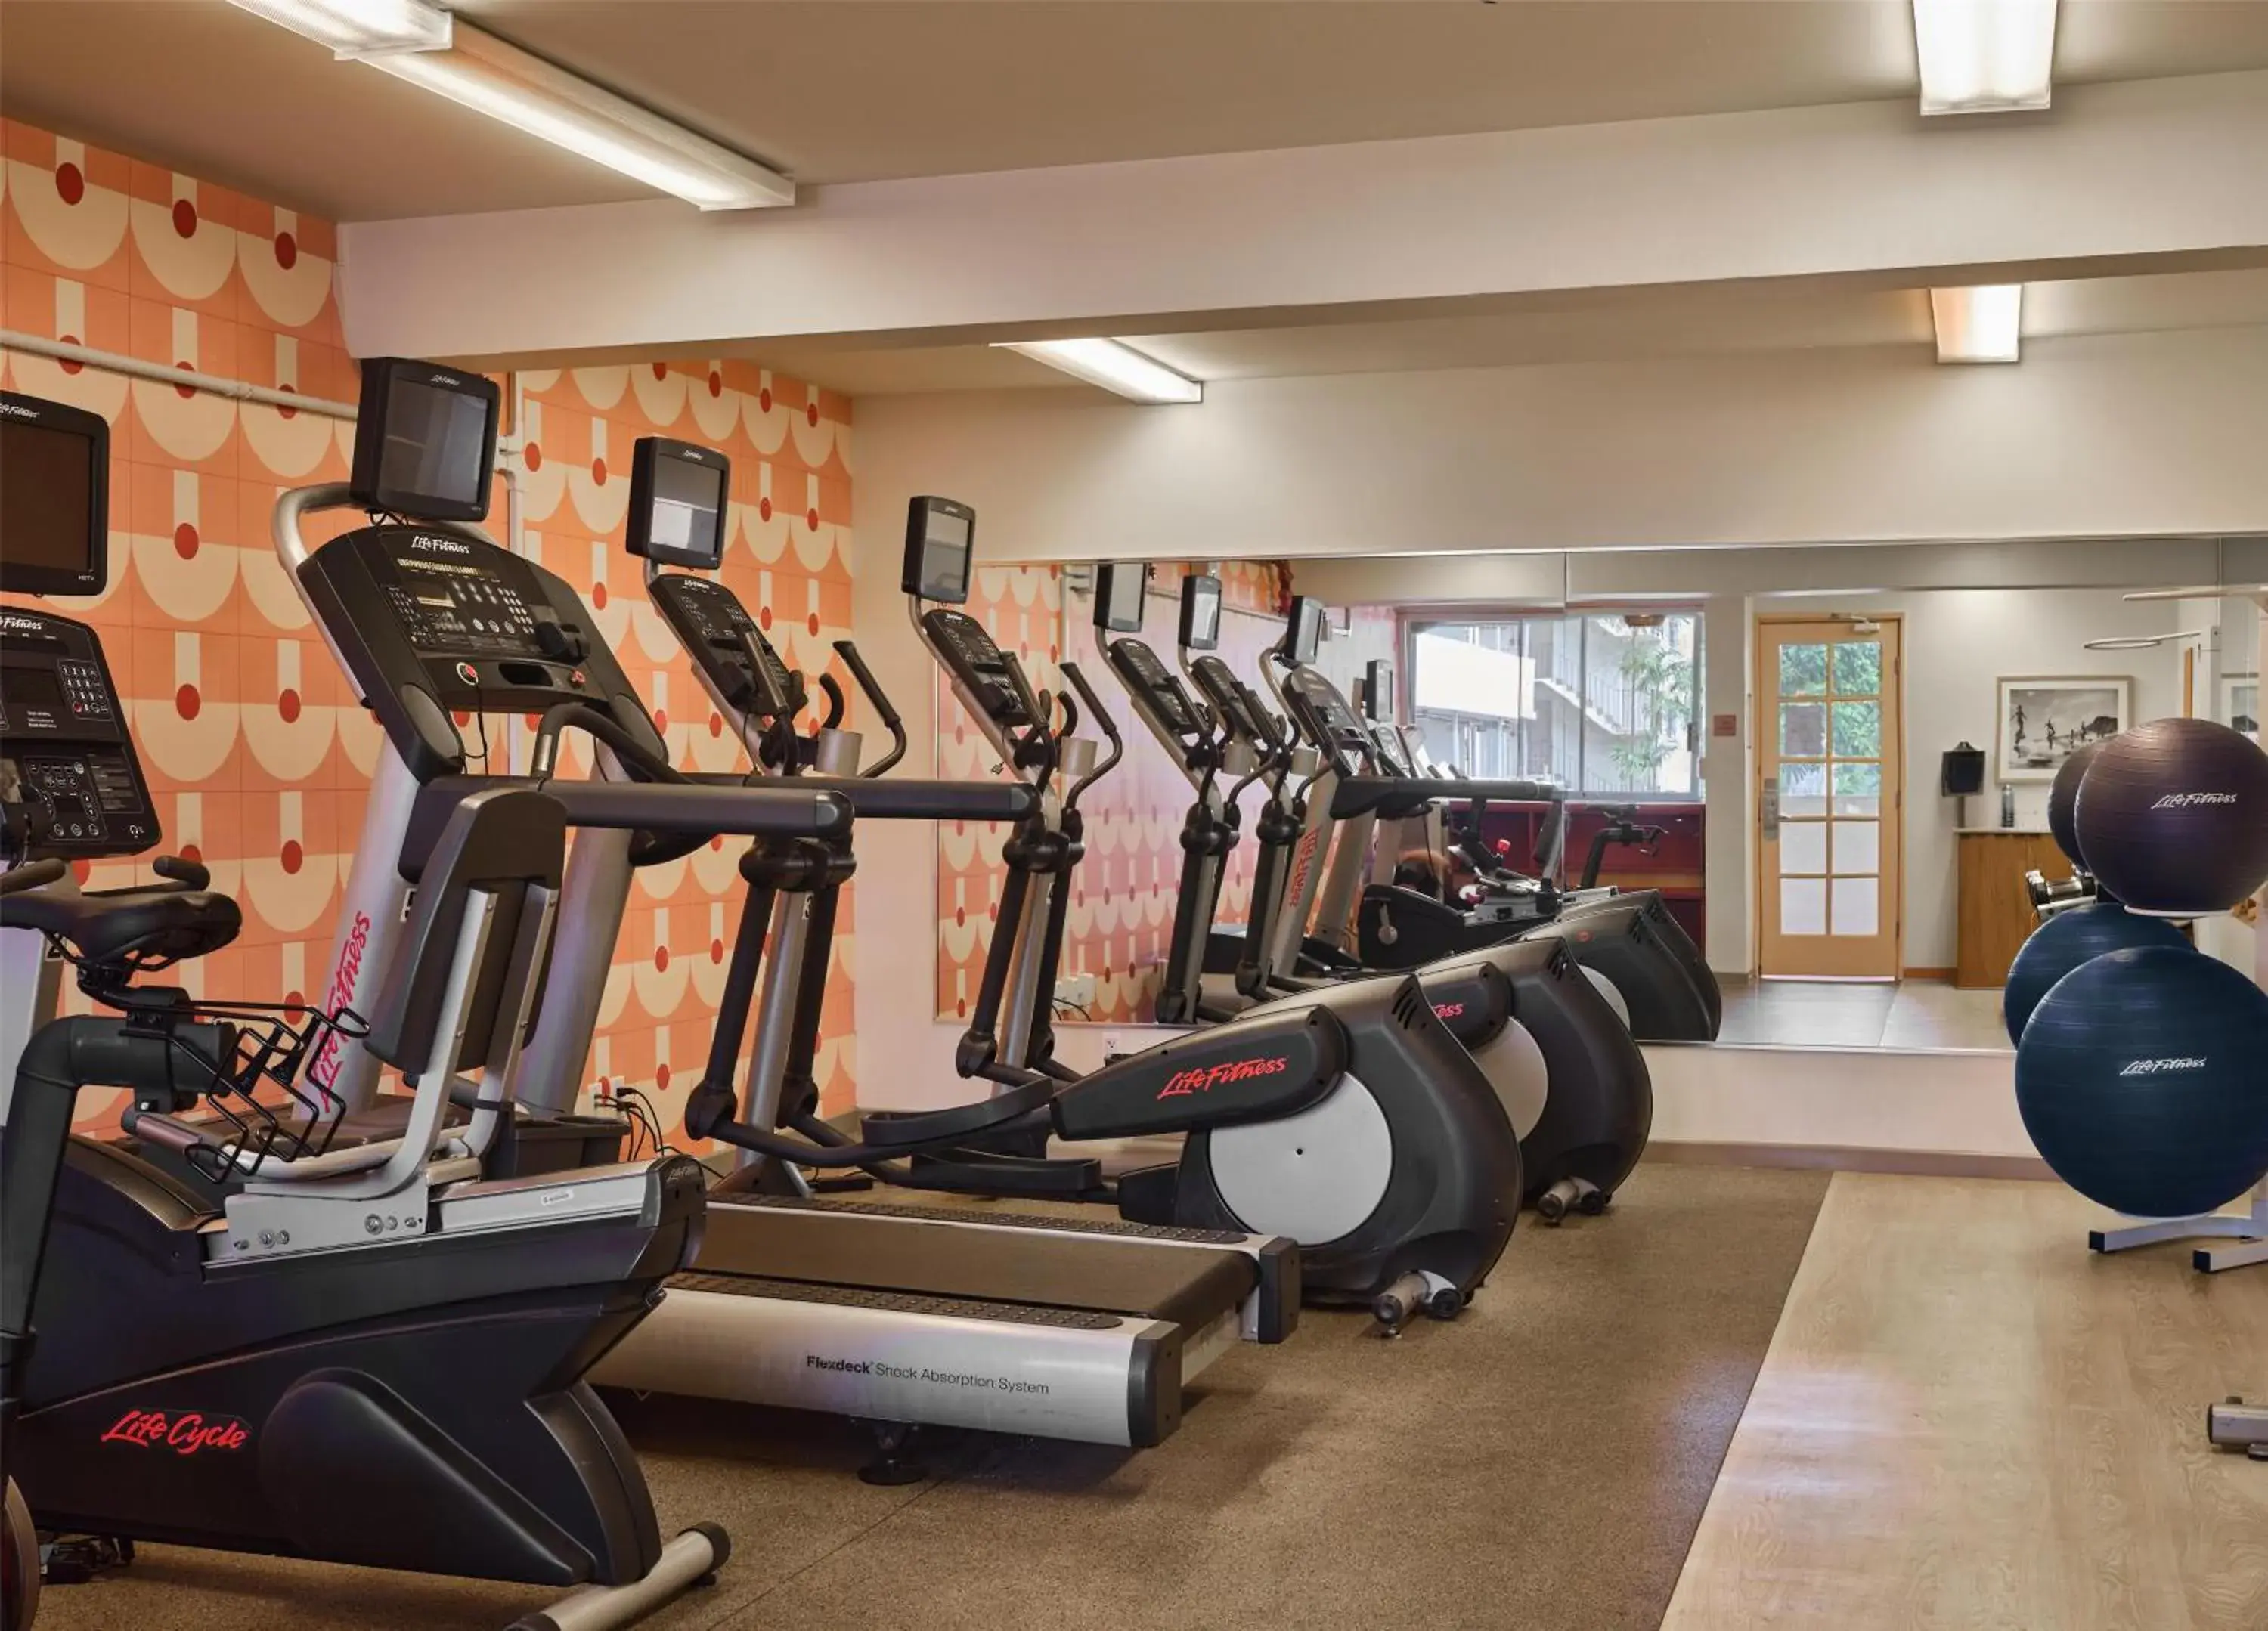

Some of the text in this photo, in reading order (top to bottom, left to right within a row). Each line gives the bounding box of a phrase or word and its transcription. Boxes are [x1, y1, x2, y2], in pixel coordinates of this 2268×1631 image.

[806, 1355, 1050, 1394] Flexdeck Shock Absorption System
[101, 1410, 248, 1454] Life Cycle
